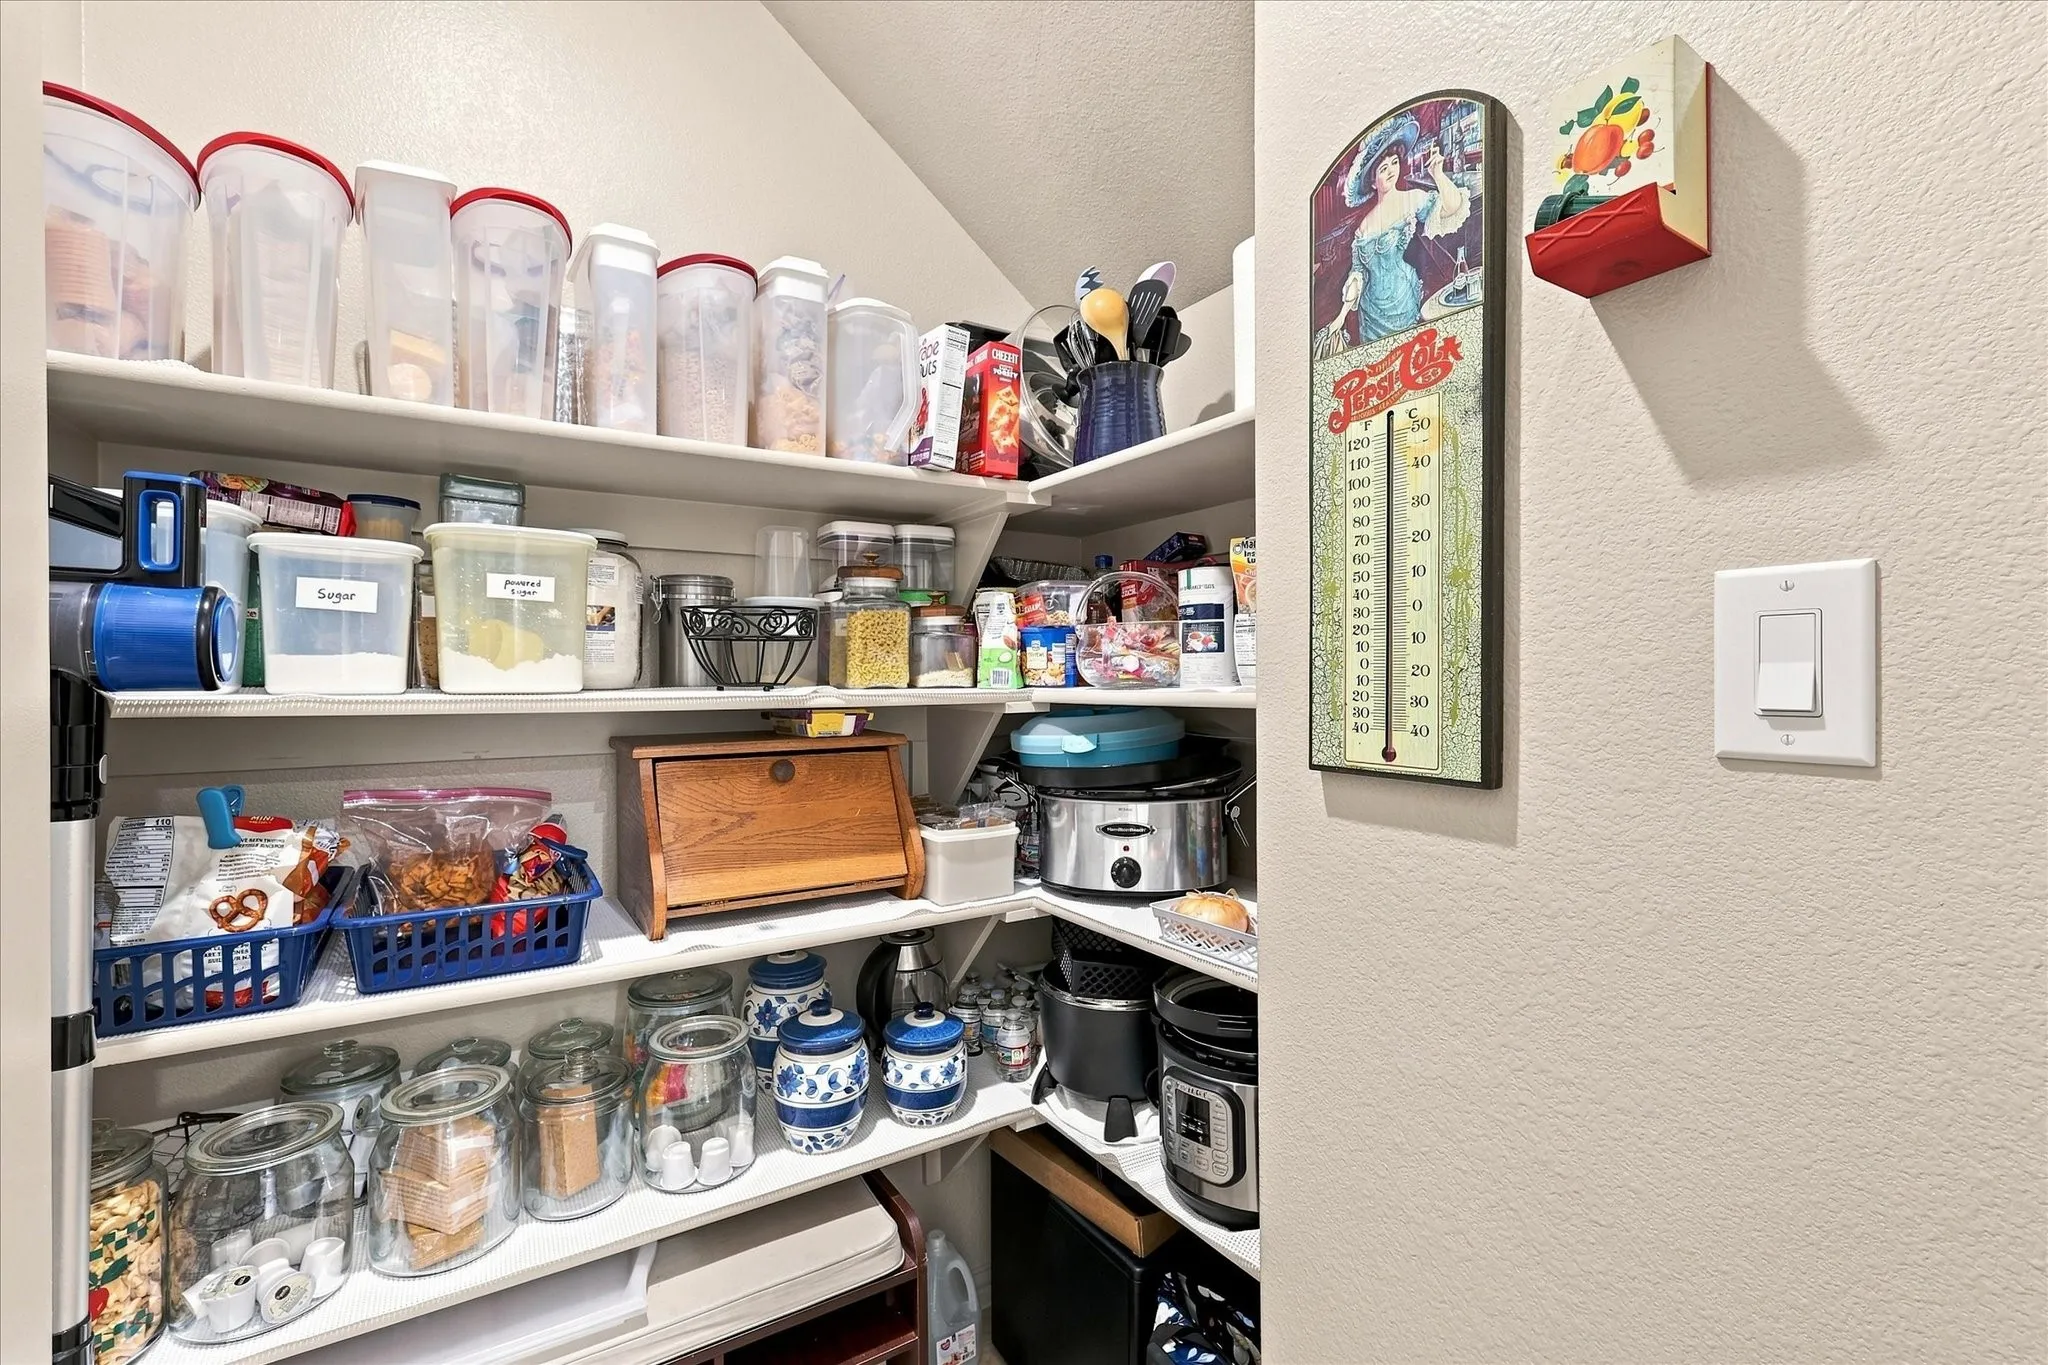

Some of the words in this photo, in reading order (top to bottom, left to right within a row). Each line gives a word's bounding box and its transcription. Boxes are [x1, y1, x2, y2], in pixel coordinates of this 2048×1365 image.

[920, 359, 938, 378] uts
[1411, 417, 1431, 432] 50
[1348, 437, 1370, 450] 120
[1350, 457, 1371, 471] 110
[1411, 454, 1432, 469] 40
[1348, 477, 1371, 490] 100
[1352, 496, 1371, 509] 90
[1411, 493, 1431, 507] 30
[1352, 515, 1371, 528] 80
[1354, 534, 1370, 547] 70
[1411, 529, 1431, 543] 20
[1352, 553, 1371, 565] 60
[1352, 570, 1371, 583] 50
[1412, 564, 1427, 578] 10
[317, 587, 357, 604] Sugar
[1352, 588, 1370, 601] 40
[1412, 599, 1423, 612] 0
[1352, 606, 1370, 619] 30
[1352, 624, 1370, 636] 20
[1412, 631, 1426, 644] 10
[1356, 640, 1370, 653] 10
[1359, 658, 1370, 670] 0
[1411, 664, 1431, 677] 20
[1356, 674, 1370, 687] 10
[1352, 690, 1370, 702] 20
[1409, 695, 1429, 708] 30
[1352, 706, 1370, 719] 30
[1351, 721, 1370, 734] 40
[1410, 724, 1430, 738] 40
[155, 818, 171, 826] 110
